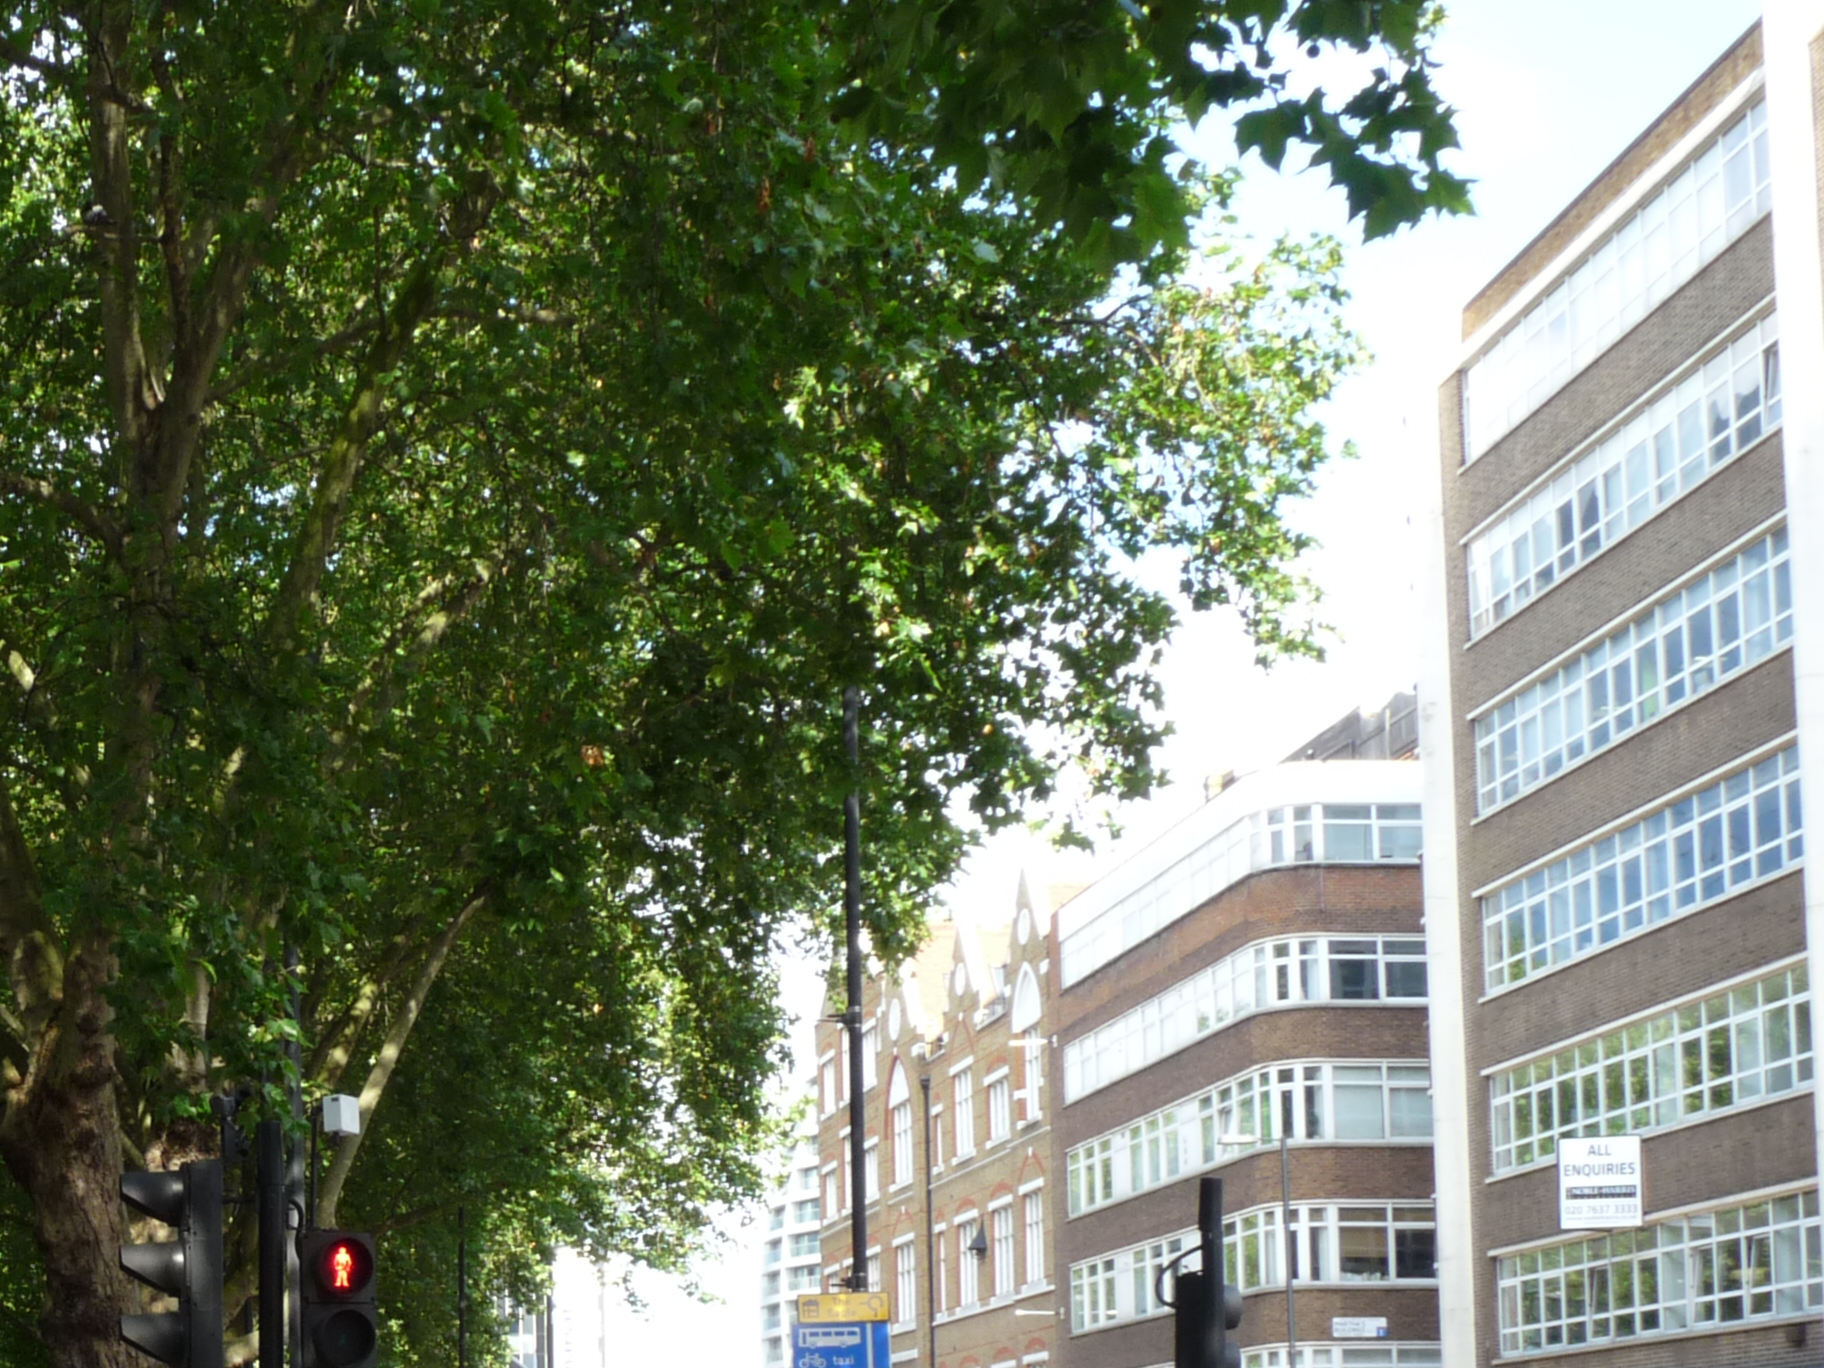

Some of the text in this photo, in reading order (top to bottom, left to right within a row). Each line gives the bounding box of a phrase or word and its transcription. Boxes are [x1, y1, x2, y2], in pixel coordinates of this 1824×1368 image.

[1587, 1144, 1612, 1157] ALL
[1564, 1162, 1635, 1177] ENQUIRIES
[1564, 1203, 1638, 1215] 020 7637 3333
[833, 1355, 854, 1366] taxi
